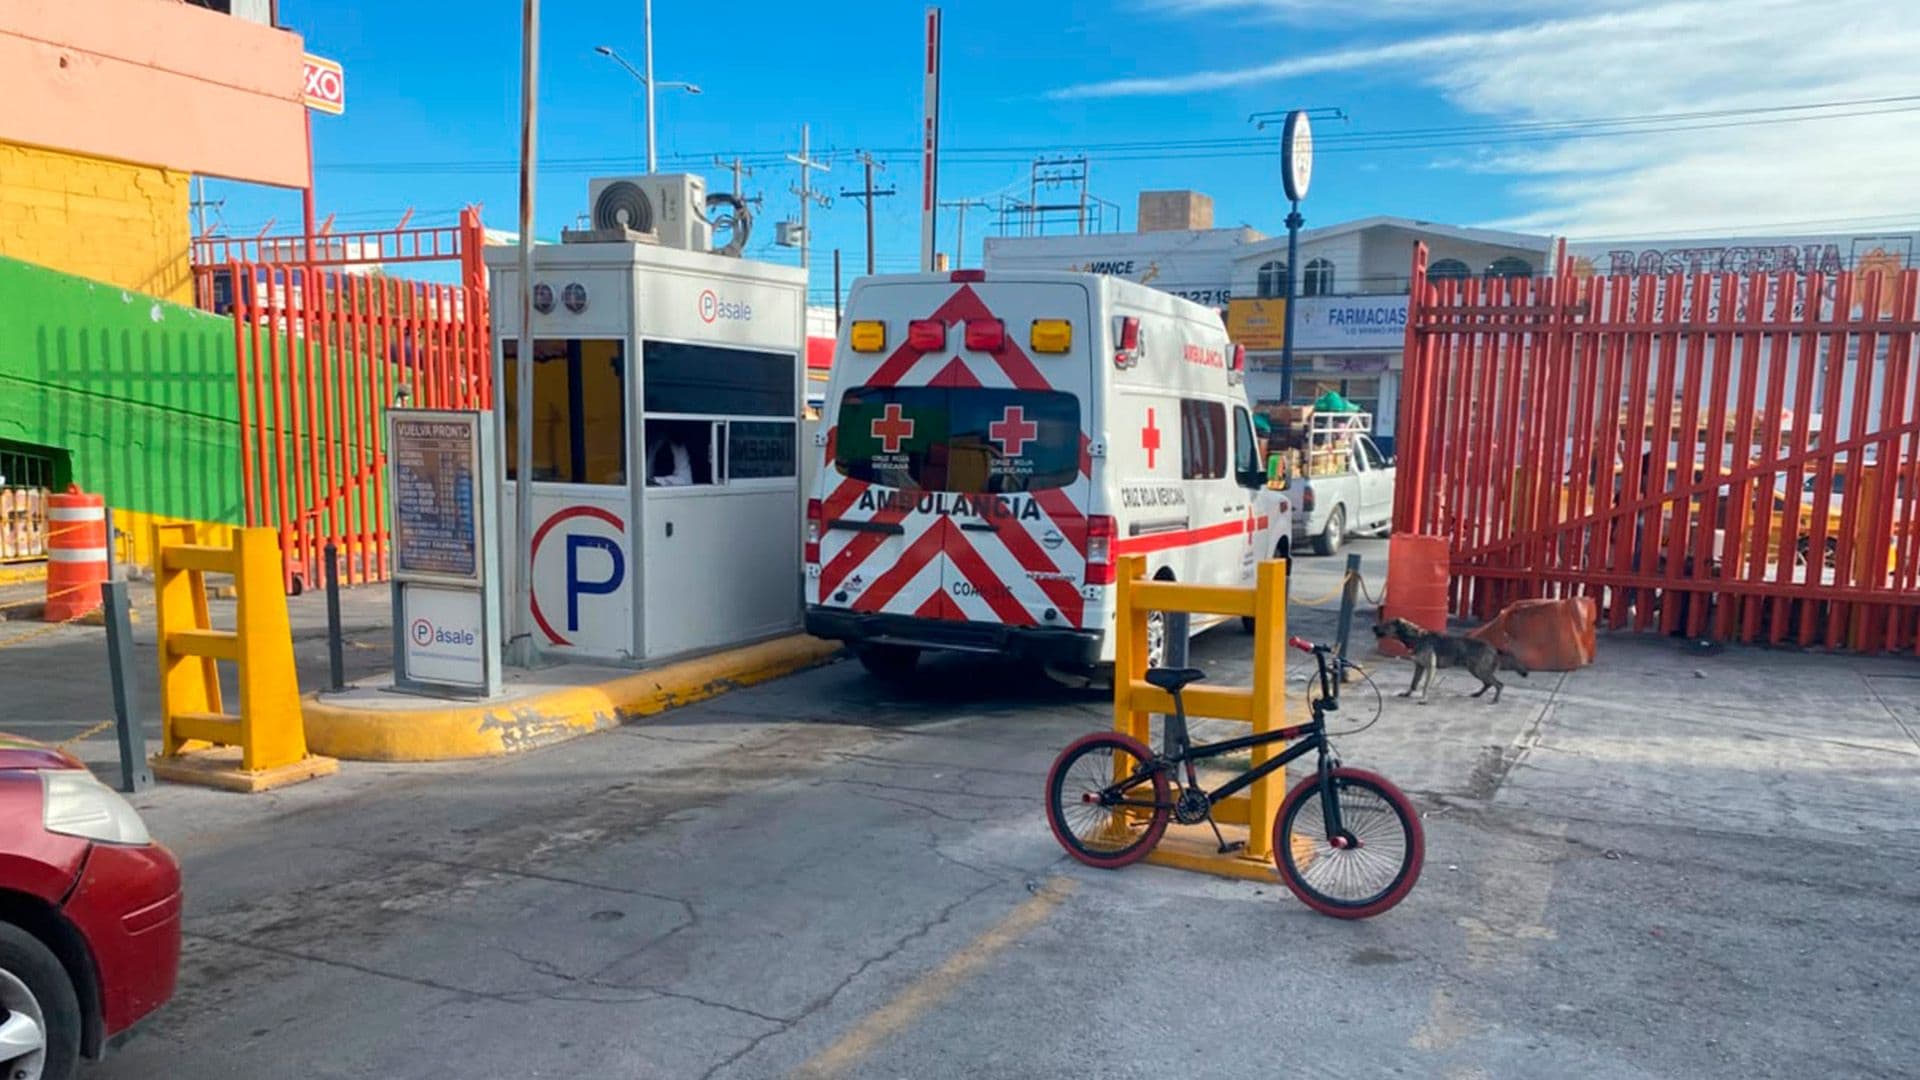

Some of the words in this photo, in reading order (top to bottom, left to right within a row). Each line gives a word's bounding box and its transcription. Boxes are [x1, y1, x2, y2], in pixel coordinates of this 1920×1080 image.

[304, 65, 340, 100] XO
[1329, 308, 1406, 325] FARMACIAS
[398, 423, 432, 437] VUELVA
[433, 424, 470, 438] PRONTO
[859, 489, 1041, 521] AMBULANCIA
[566, 535, 624, 631] P
[413, 621, 474, 645] Pásale
